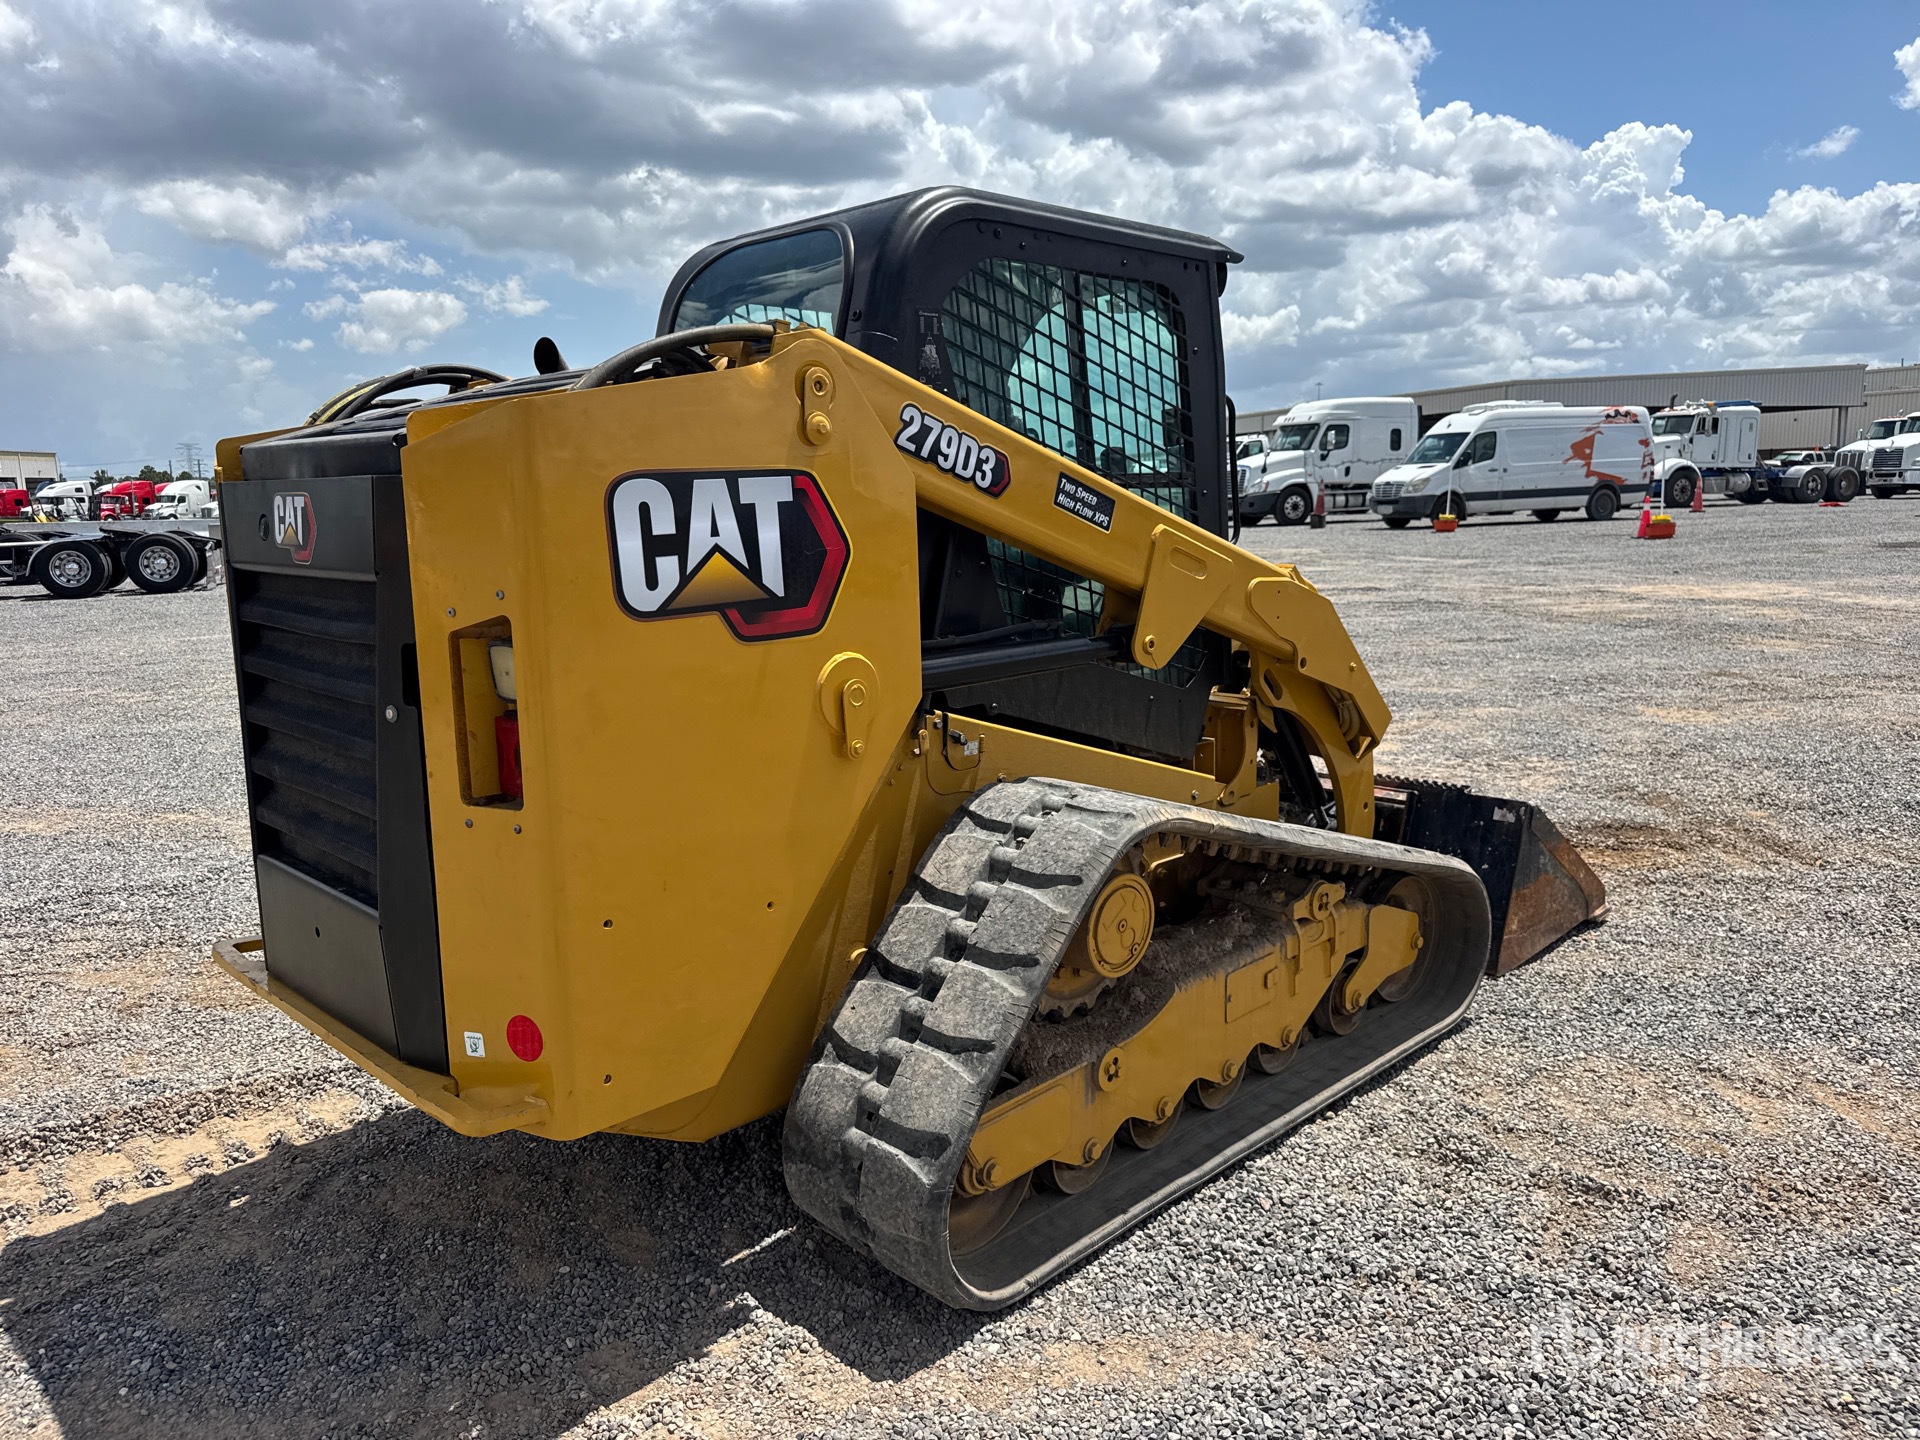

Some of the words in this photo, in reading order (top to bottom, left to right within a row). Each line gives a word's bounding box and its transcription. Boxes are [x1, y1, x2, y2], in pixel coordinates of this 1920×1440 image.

[897, 406, 997, 489] 279D3
[1056, 493, 1076, 510] HIGH
[1074, 502, 1095, 519] FLOW
[1093, 511, 1110, 527] XPS
[1060, 478, 1076, 495] TWO
[1075, 487, 1098, 506] SPEED
[273, 495, 305, 546] CAT
[613, 475, 794, 612] CAT
